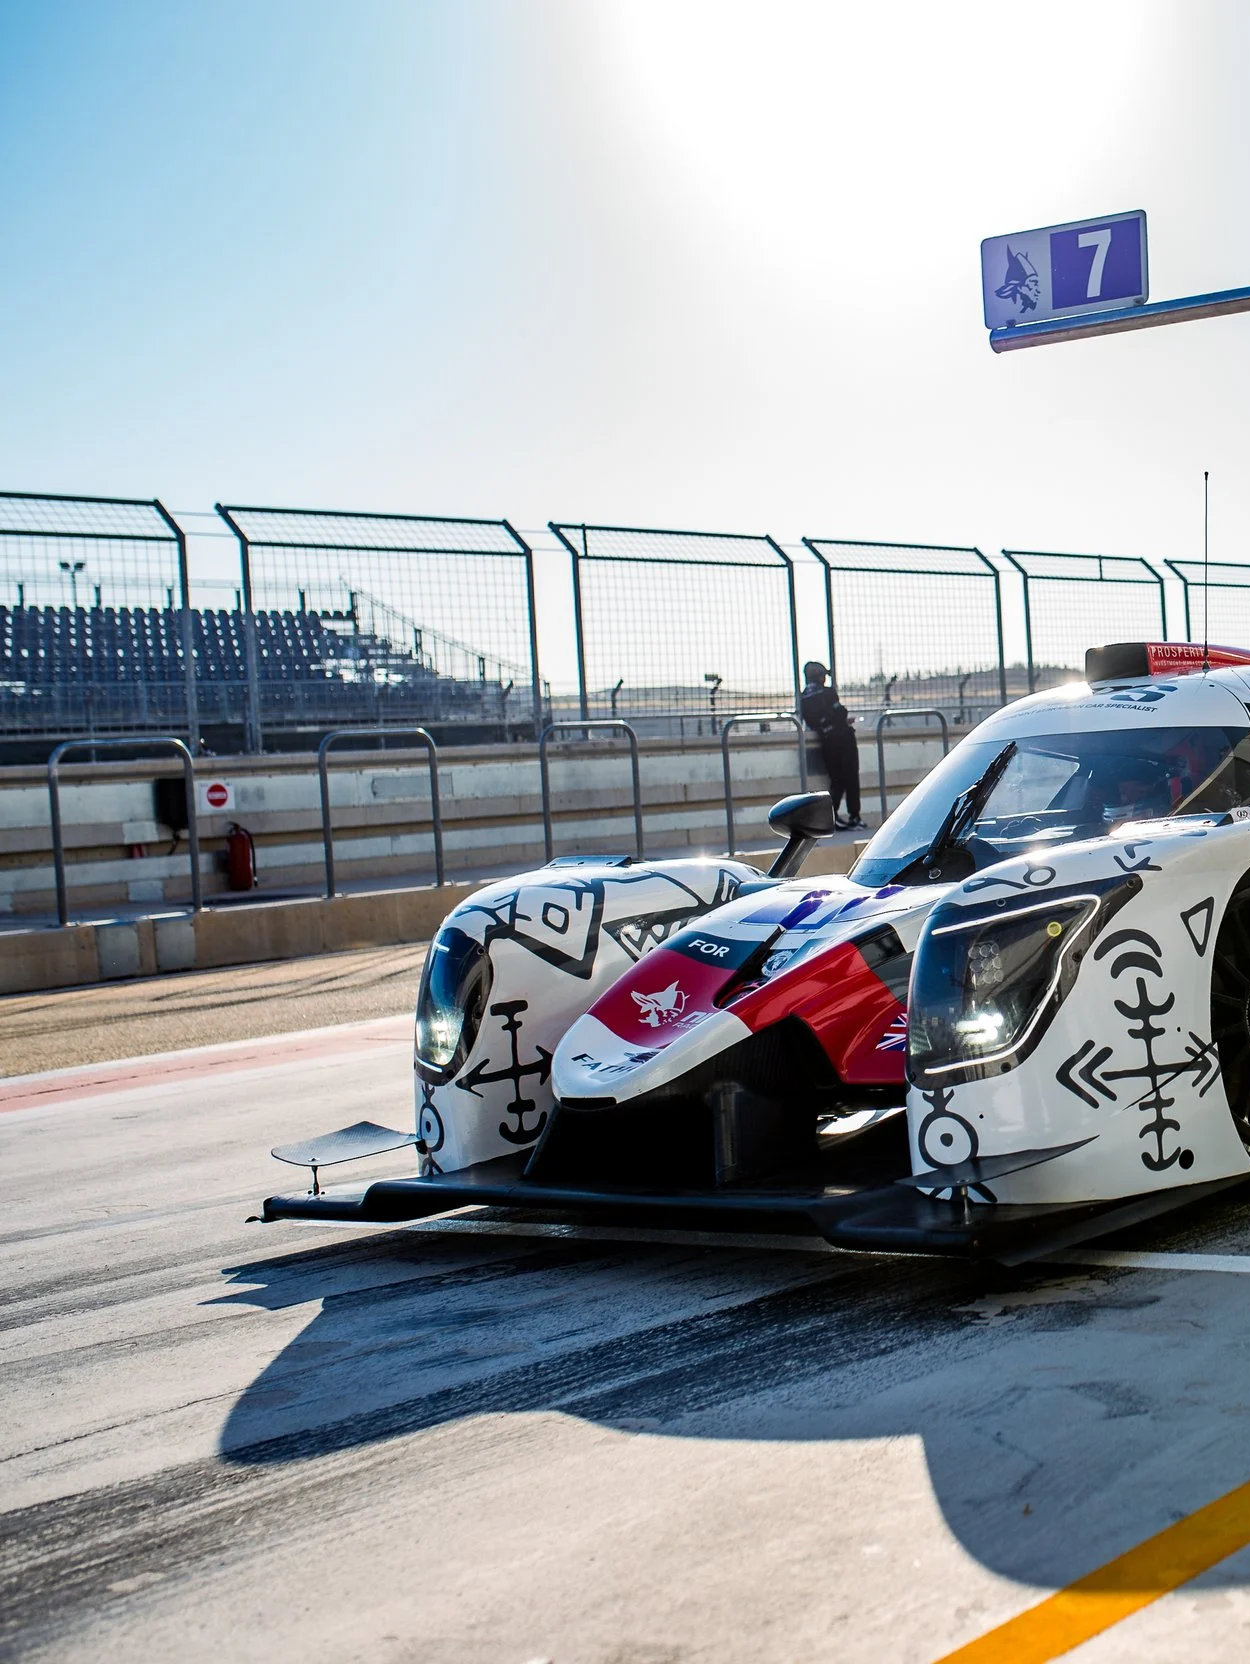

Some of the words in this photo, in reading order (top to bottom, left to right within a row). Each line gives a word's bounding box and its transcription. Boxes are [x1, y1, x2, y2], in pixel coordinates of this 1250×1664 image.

[1077, 228, 1112, 299] 7
[1104, 703, 1158, 713] SPECIALIST
[688, 938, 730, 958] FOR
